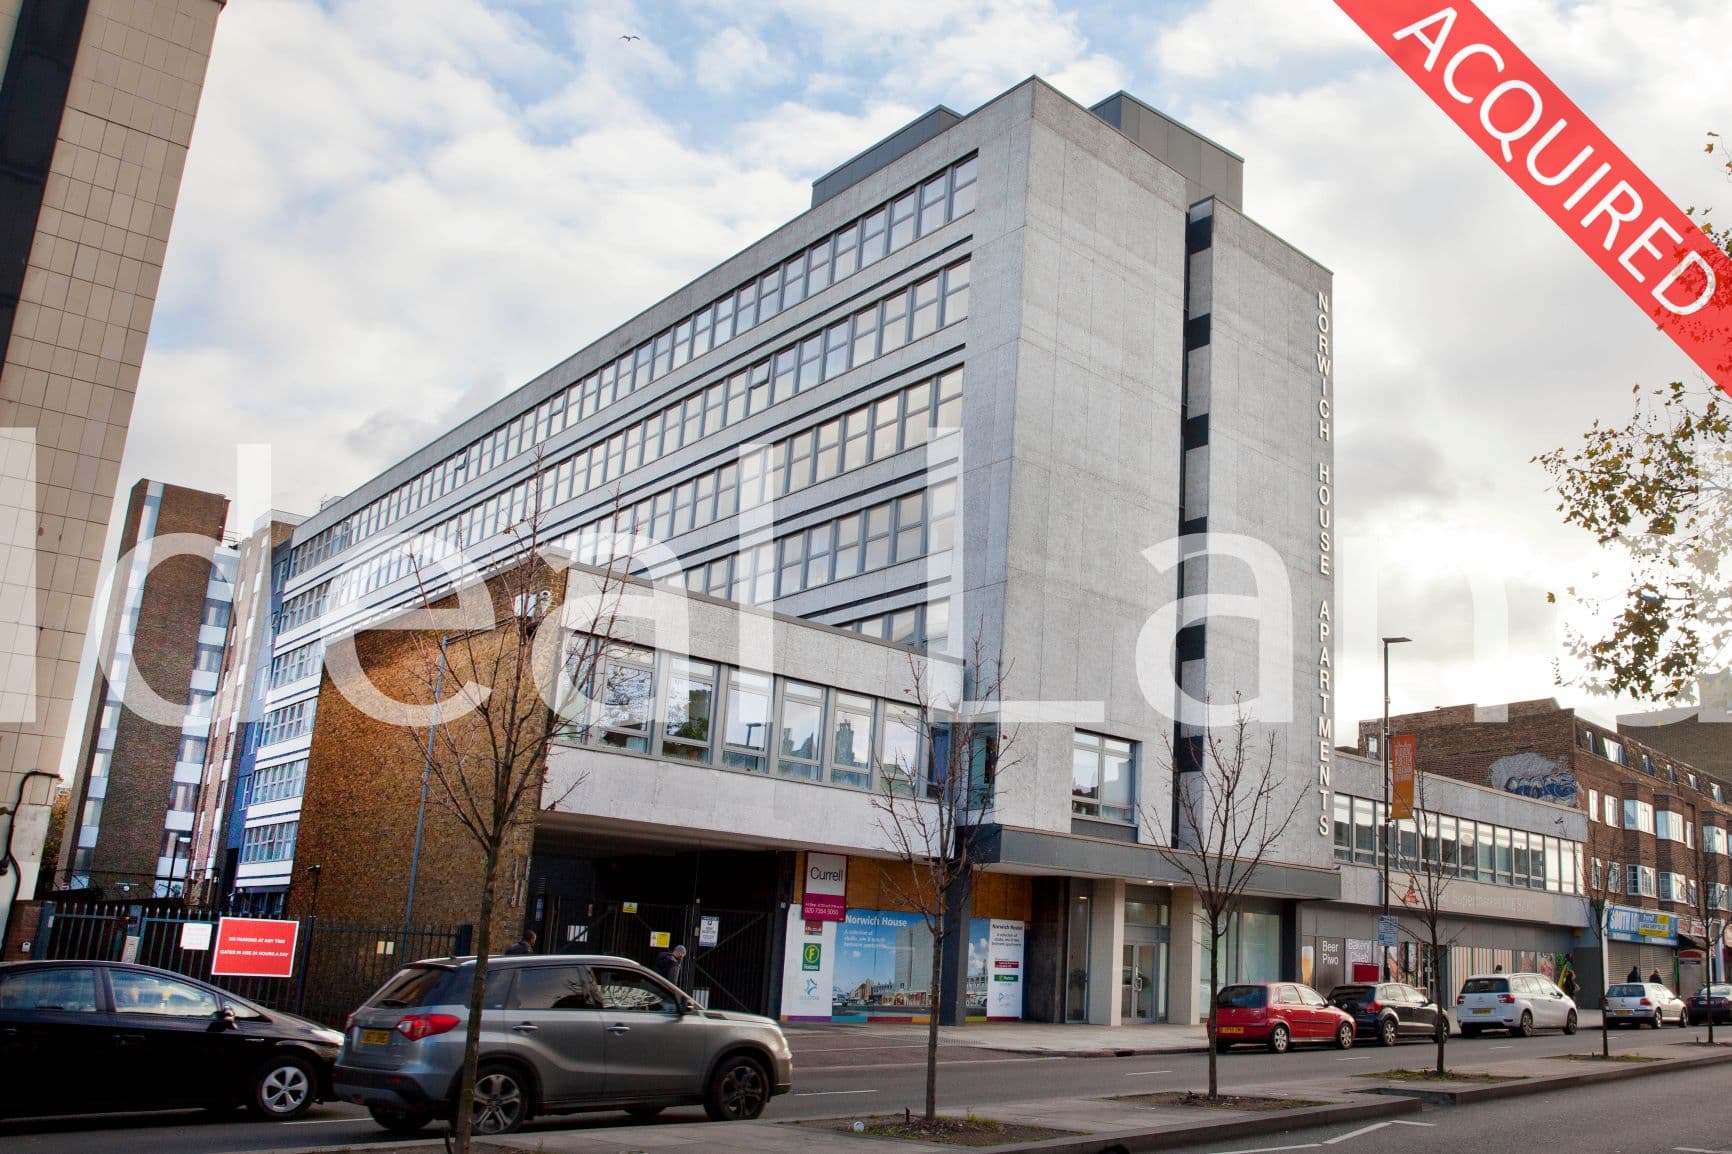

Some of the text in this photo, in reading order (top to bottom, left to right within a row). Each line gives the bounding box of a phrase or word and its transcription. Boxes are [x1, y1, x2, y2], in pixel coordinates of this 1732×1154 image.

[1316, 291, 1331, 837] NORWICH HOUSE APARTMENTS
[810, 866, 844, 882] Currell
[845, 914, 908, 927] Norwich House
[1322, 940, 1339, 952] Beer
[1322, 953, 1339, 965] Piwo
